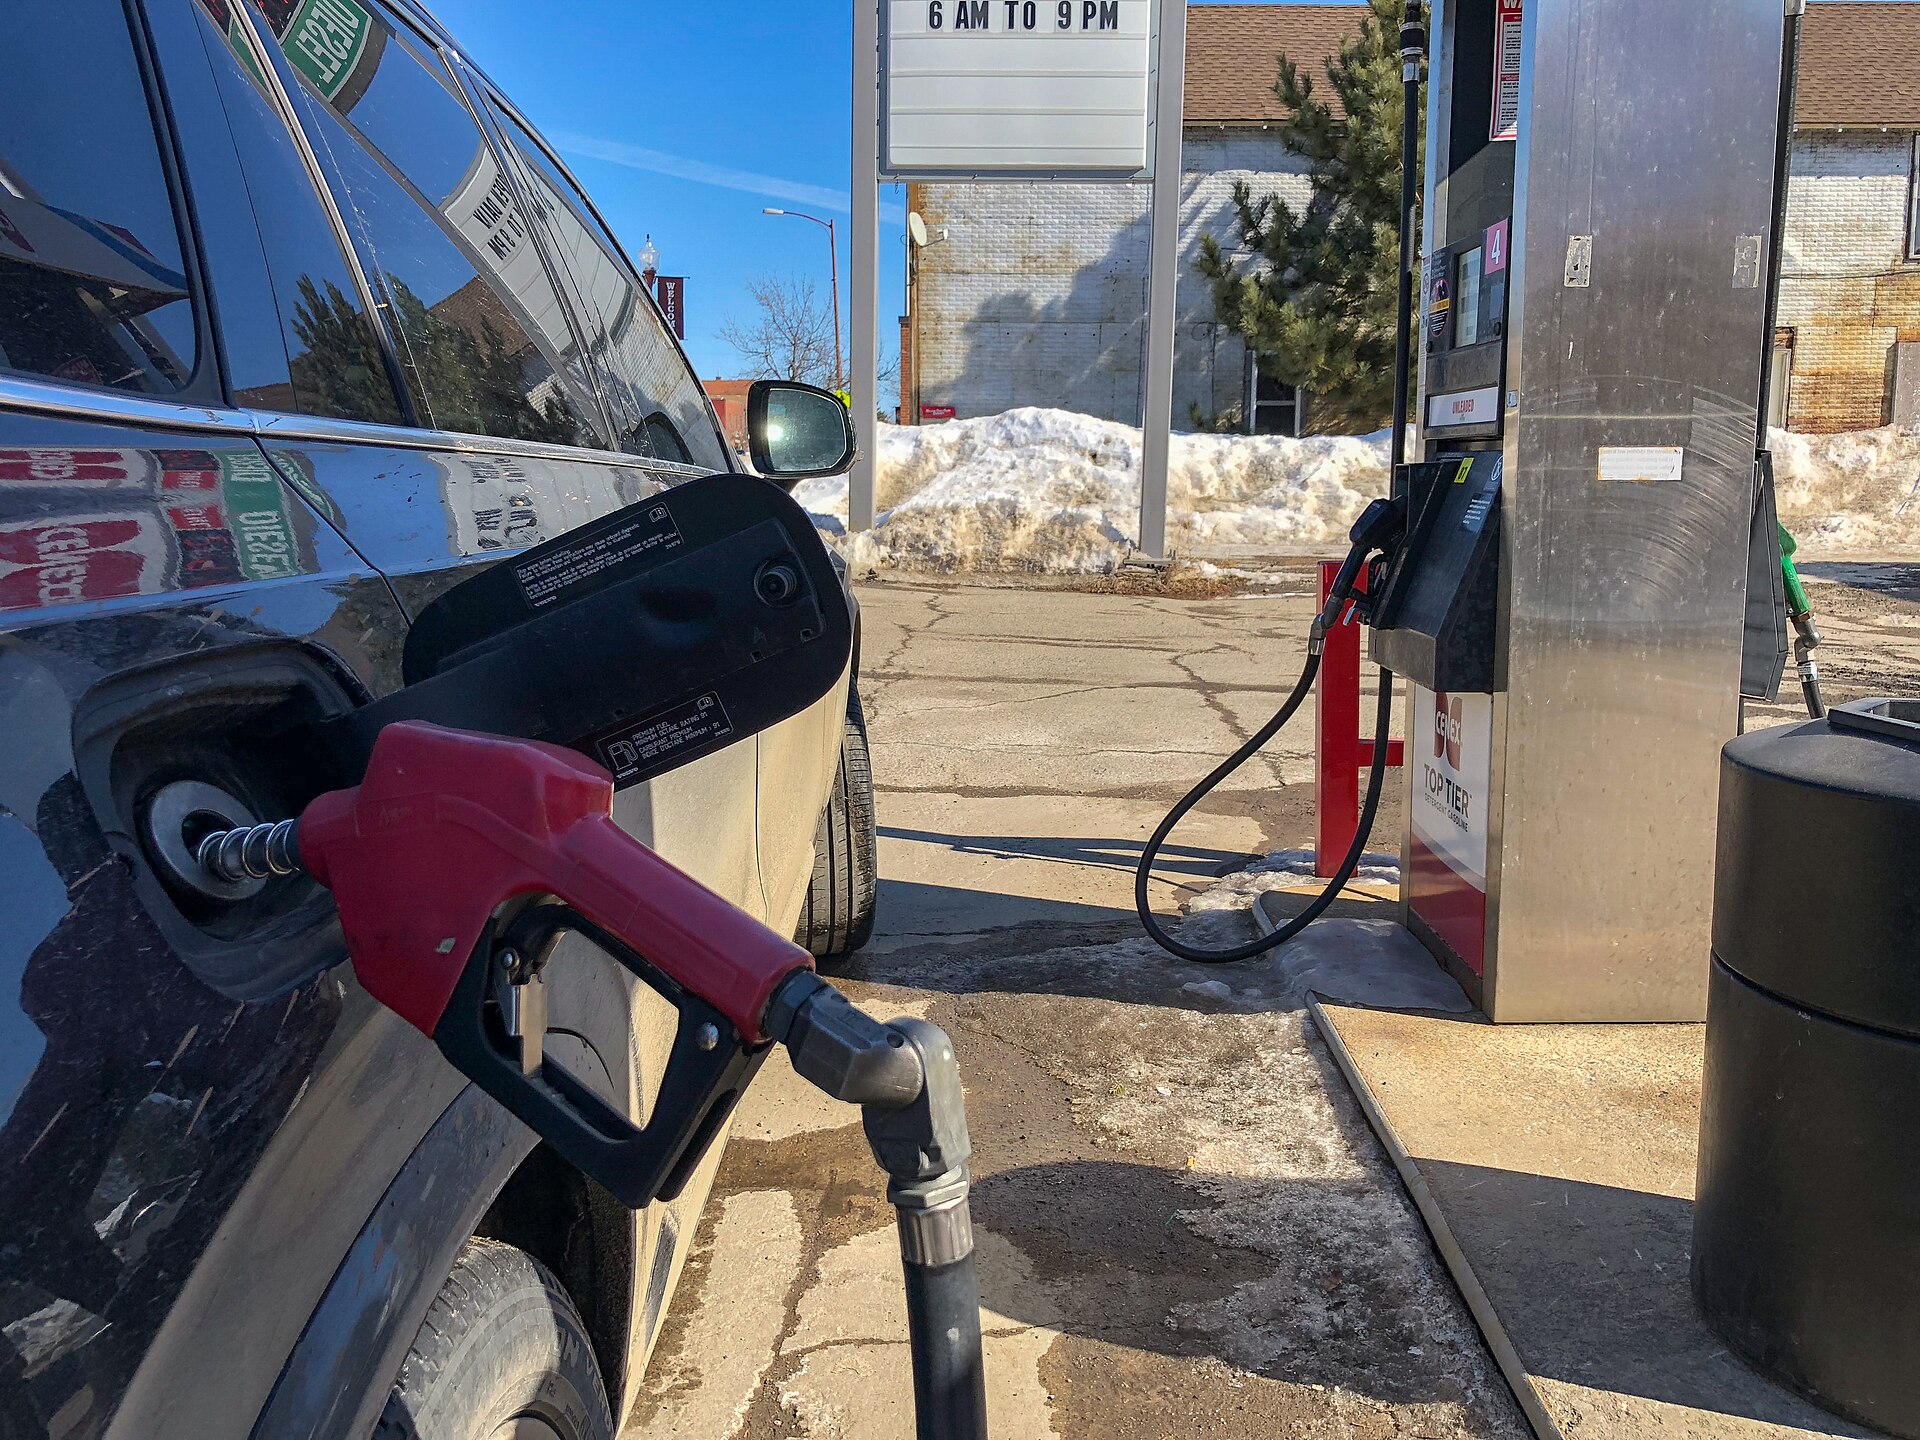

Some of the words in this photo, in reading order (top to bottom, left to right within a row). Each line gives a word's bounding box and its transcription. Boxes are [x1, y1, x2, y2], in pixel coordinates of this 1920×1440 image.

[929, 0, 943, 30] 6
[955, 0, 989, 30] AM
[1004, 0, 1036, 30] TO
[1057, 0, 1072, 30] 9
[1082, 0, 1119, 30] PM
[1491, 229, 1501, 265] 4
[1452, 399, 1475, 414] UNLEADED
[632, 727, 655, 740] PREMIUM
[656, 720, 669, 729] FUEL
[635, 733, 657, 745] MINIMUM
[658, 723, 678, 735] OCTANE
[679, 714, 699, 726] RATING
[638, 737, 667, 753] CARBURANT
[669, 726, 692, 739] PREMIUM
[642, 748, 658, 758] INDICE
[685, 727, 708, 739] MINIMUM
[1435, 711, 1461, 746] CENEX
[1424, 764, 1444, 796] TOP
[1447, 809, 1469, 832] GASOLINE
